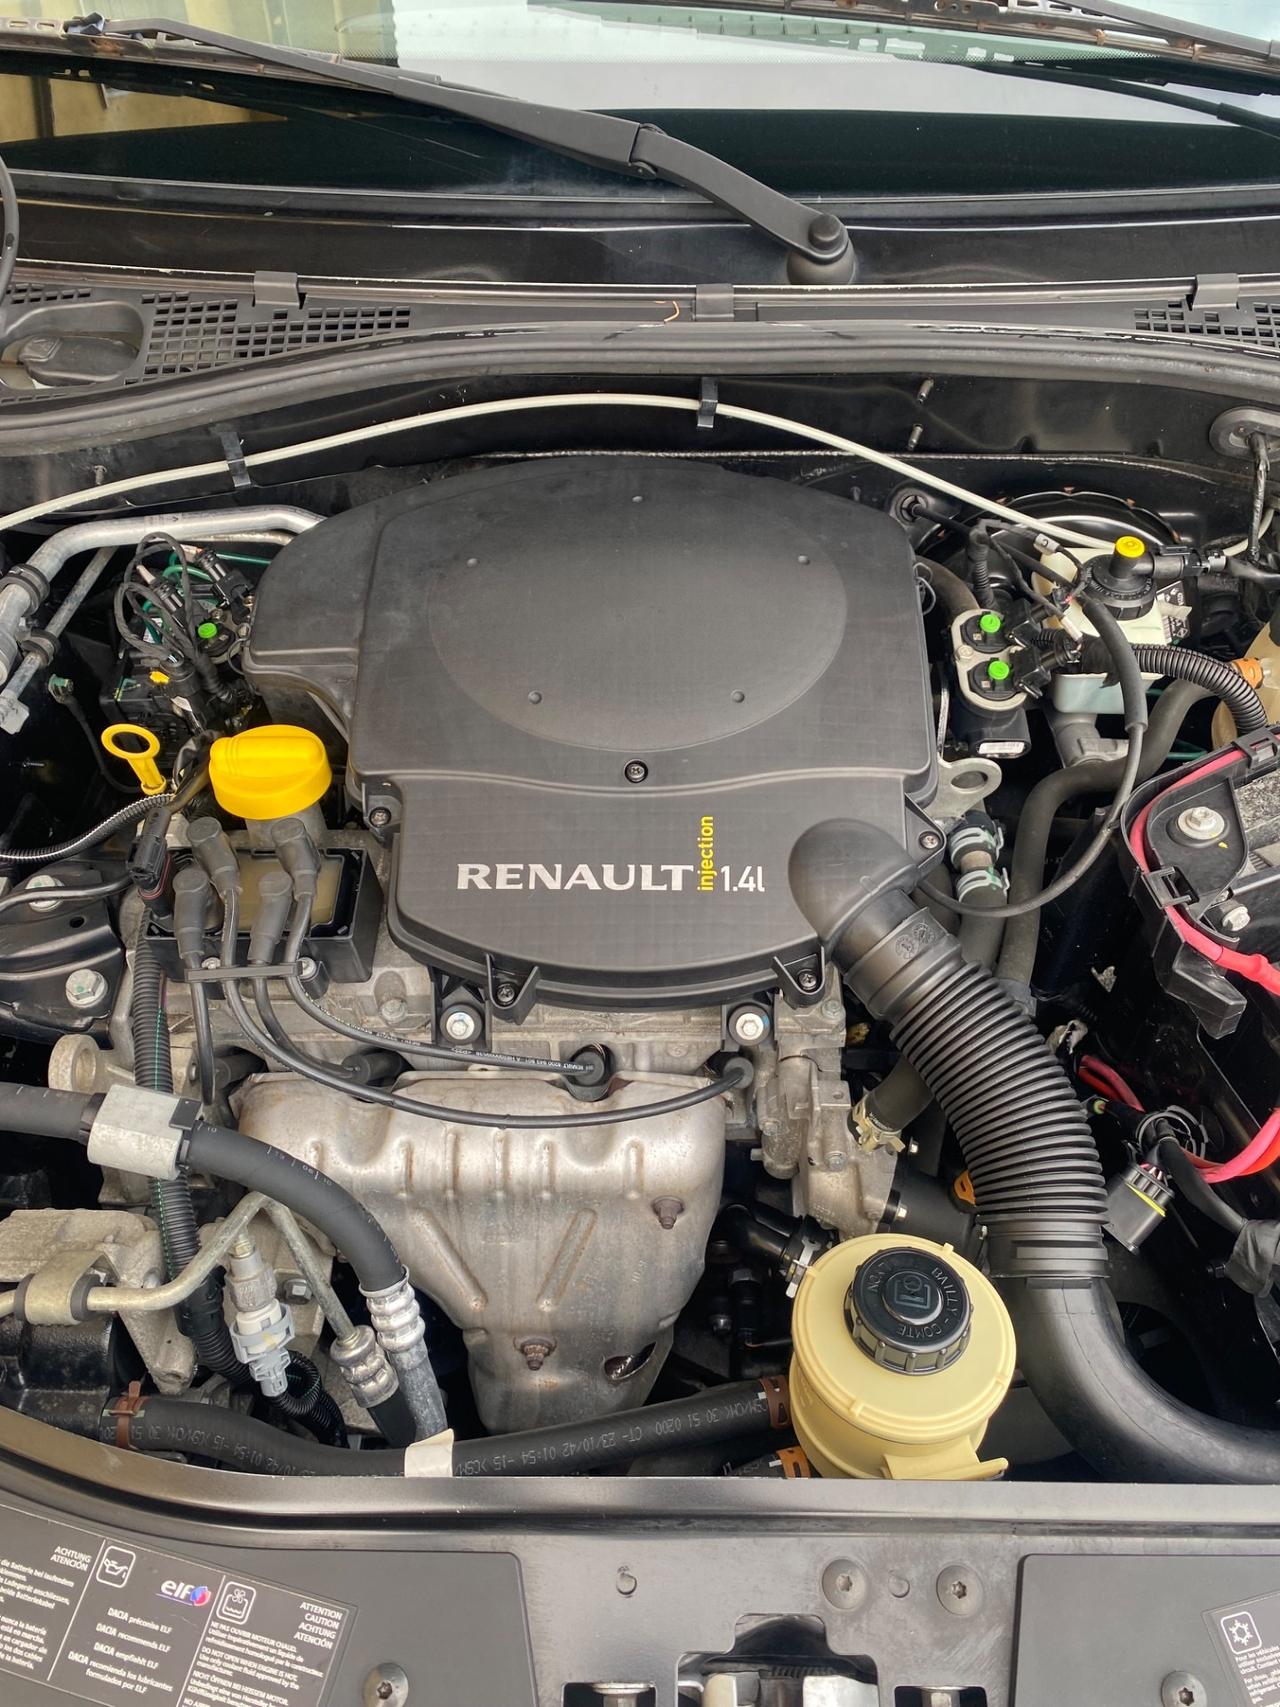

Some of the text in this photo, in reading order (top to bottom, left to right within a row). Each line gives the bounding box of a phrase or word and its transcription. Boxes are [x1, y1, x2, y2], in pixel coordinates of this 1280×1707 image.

[697, 816, 717, 891] injection
[457, 863, 694, 891] RENAULT
[51, 1554, 88, 1571] ATENCIÓN
[55, 1547, 91, 1562] ACHTUNG
[161, 1579, 195, 1600] elf
[300, 1602, 343, 1620] ATTENTION
[108, 1608, 128, 1620] DACIA
[160, 1625, 172, 1633] ELF
[305, 1613, 340, 1629] CAUTION
[96, 1623, 170, 1652] DACIA recommends ELF
[298, 1622, 336, 1639] ACHTUNG
[293, 1631, 333, 1650] ATENCIÓN
[68, 1651, 89, 1665] DACIA
[94, 1643, 114, 1655] DACIA
[147, 1660, 158, 1669] ELF
[135, 1685, 147, 1693] ELF
